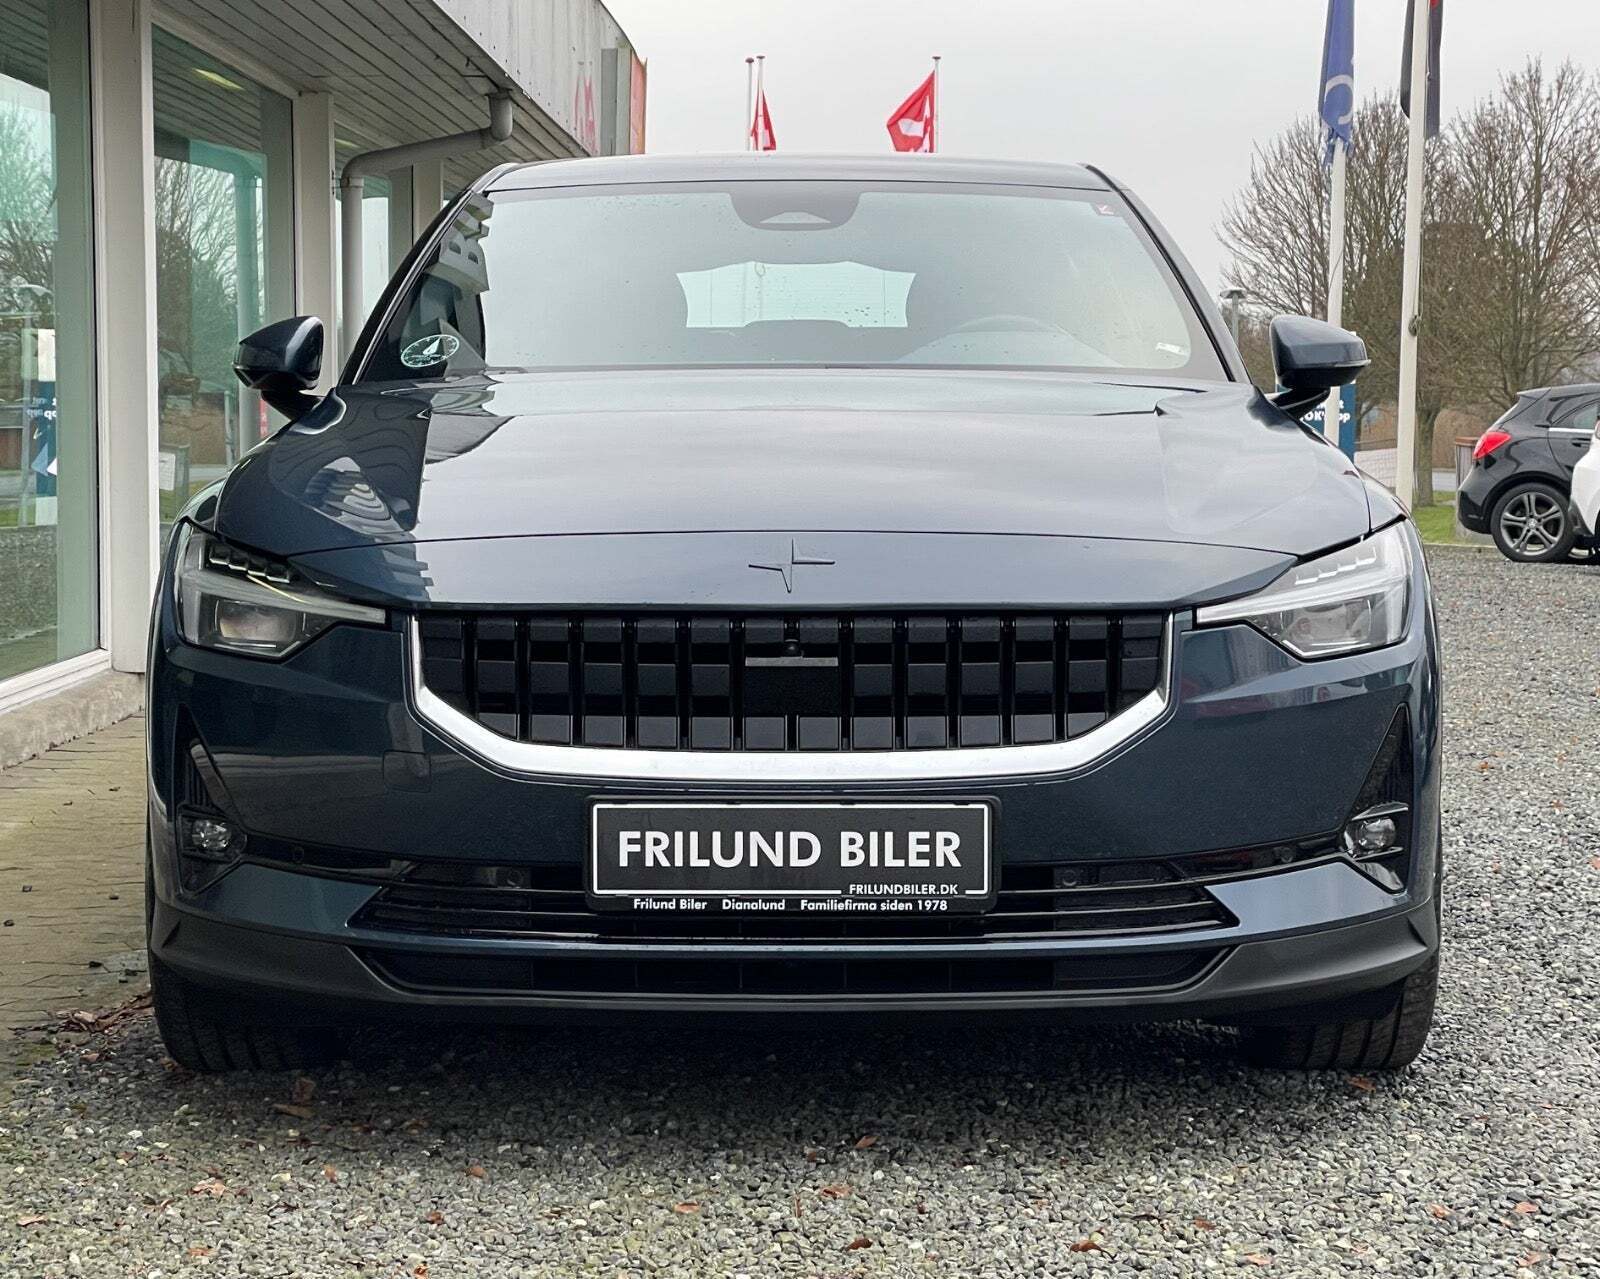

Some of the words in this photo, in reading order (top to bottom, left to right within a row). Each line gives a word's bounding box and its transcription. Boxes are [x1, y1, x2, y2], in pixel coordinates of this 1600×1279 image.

[619, 830, 822, 868] FRILUND
[840, 830, 962, 868] BILER
[848, 883, 959, 896] FRILUNDBILER.DK
[633, 898, 676, 910] Frilund
[679, 898, 708, 910] Biler
[722, 898, 786, 910] Dianalund
[800, 899, 877, 911] Familiefirma
[880, 899, 913, 911] siden
[917, 899, 948, 911] 1978
